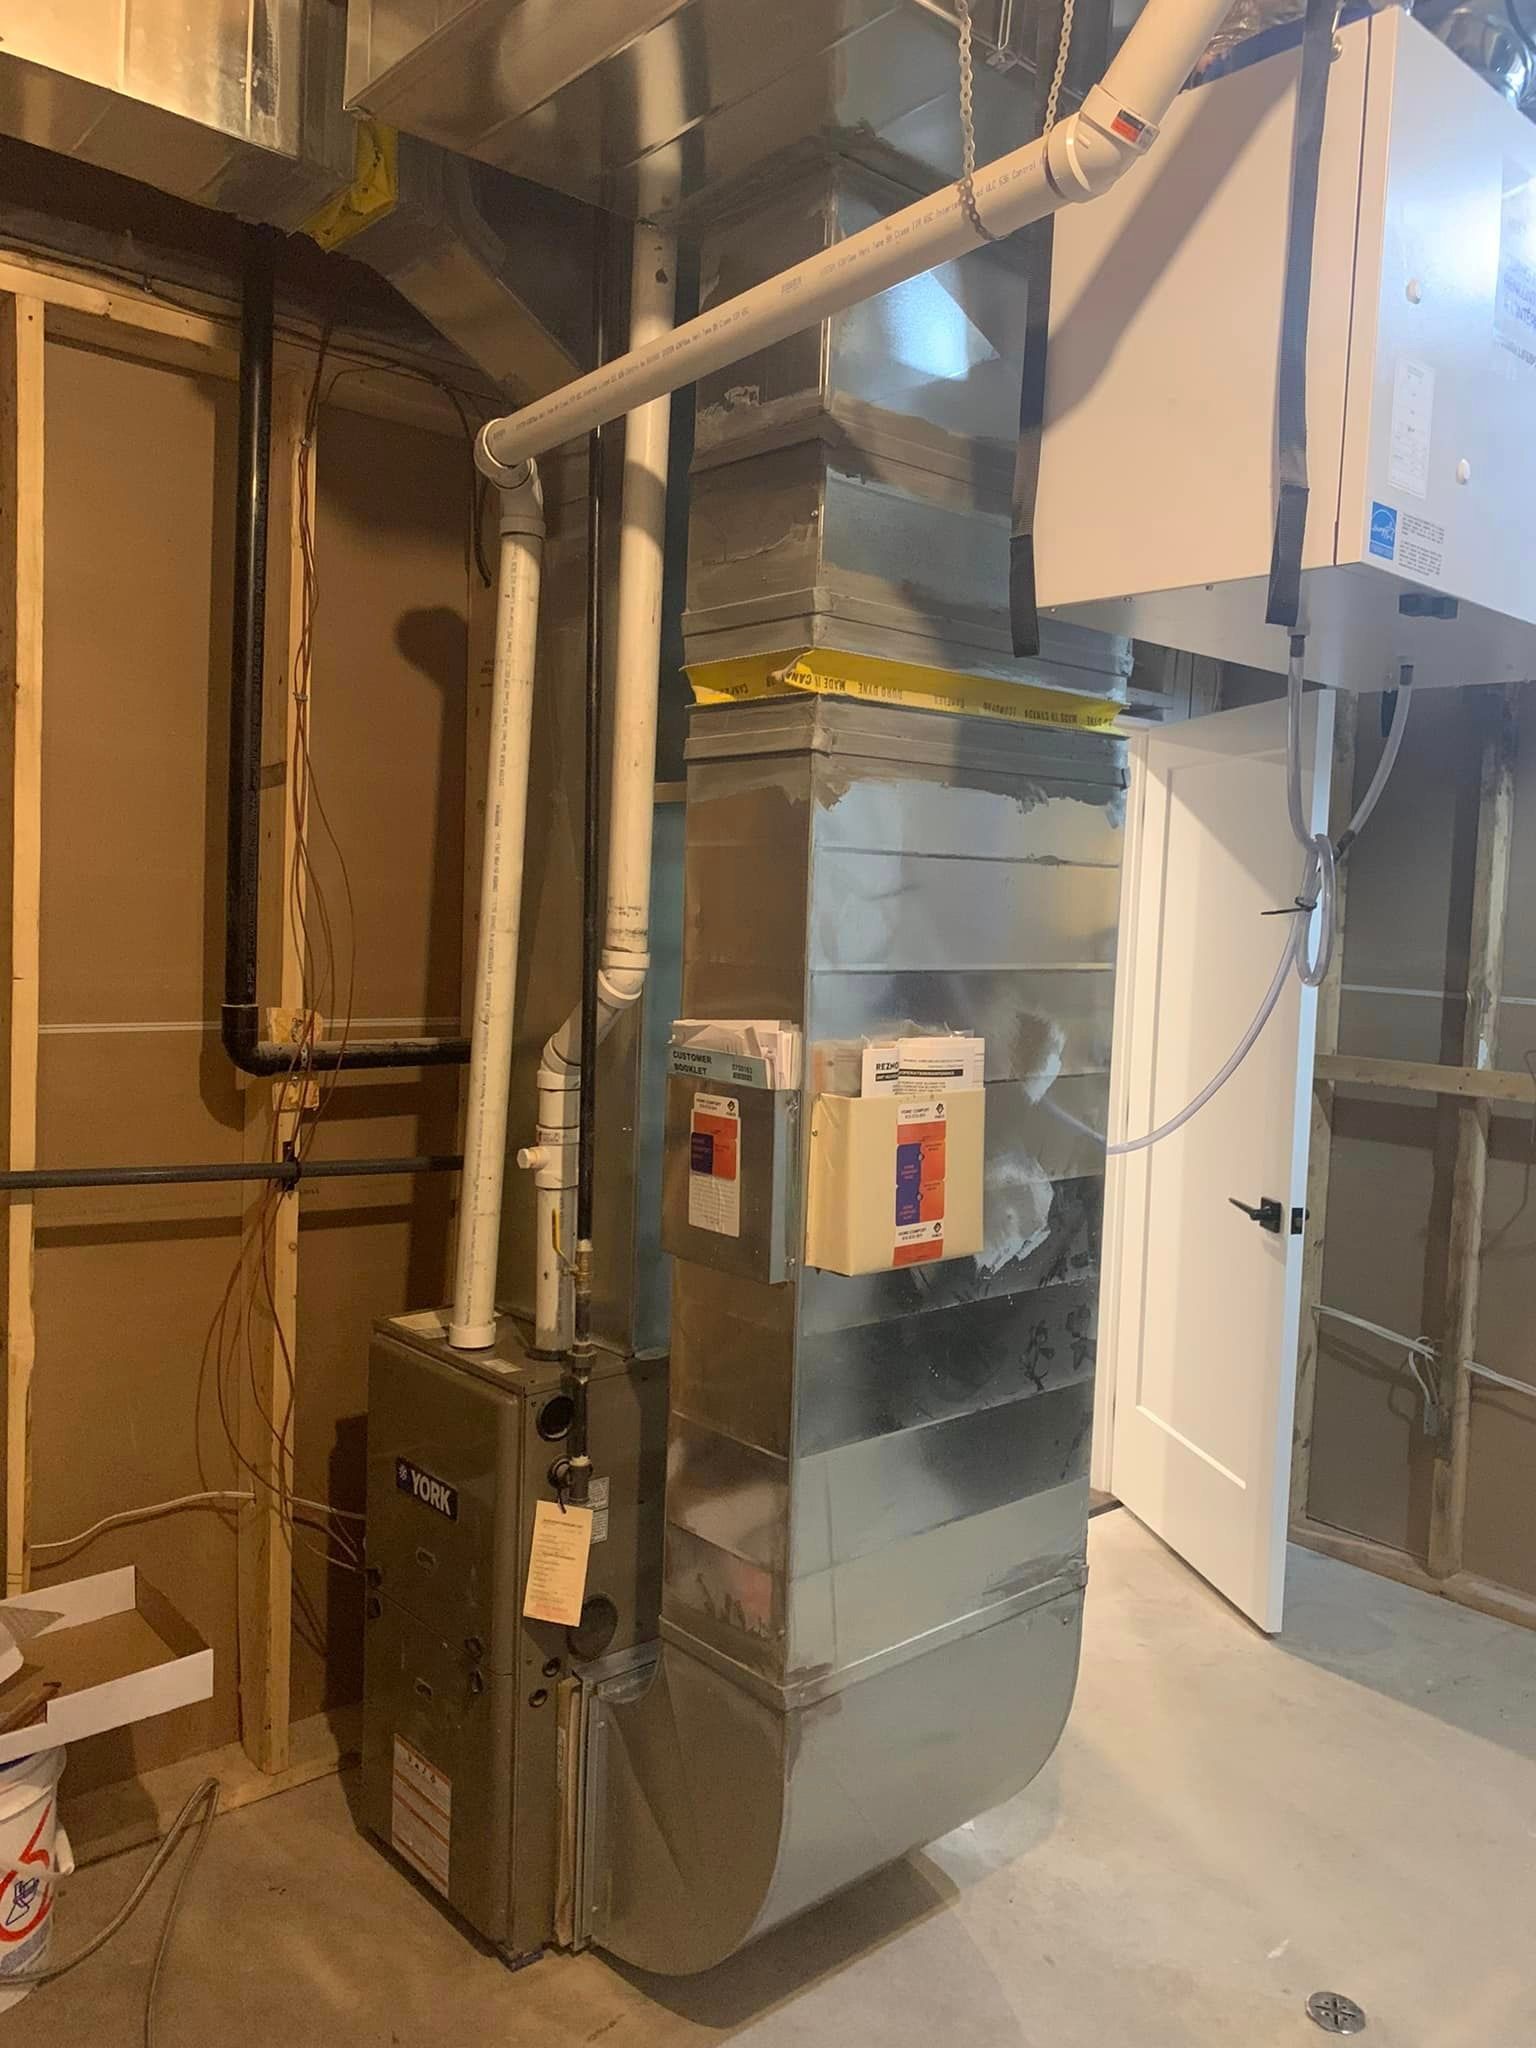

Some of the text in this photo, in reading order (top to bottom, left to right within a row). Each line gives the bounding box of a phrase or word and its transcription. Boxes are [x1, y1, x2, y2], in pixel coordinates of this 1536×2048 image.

[823, 676, 846, 692] MADE
[673, 1050, 712, 1064] CUSTOMER
[674, 1063, 707, 1075] BOOKLET
[411, 1469, 451, 1516] YORK
